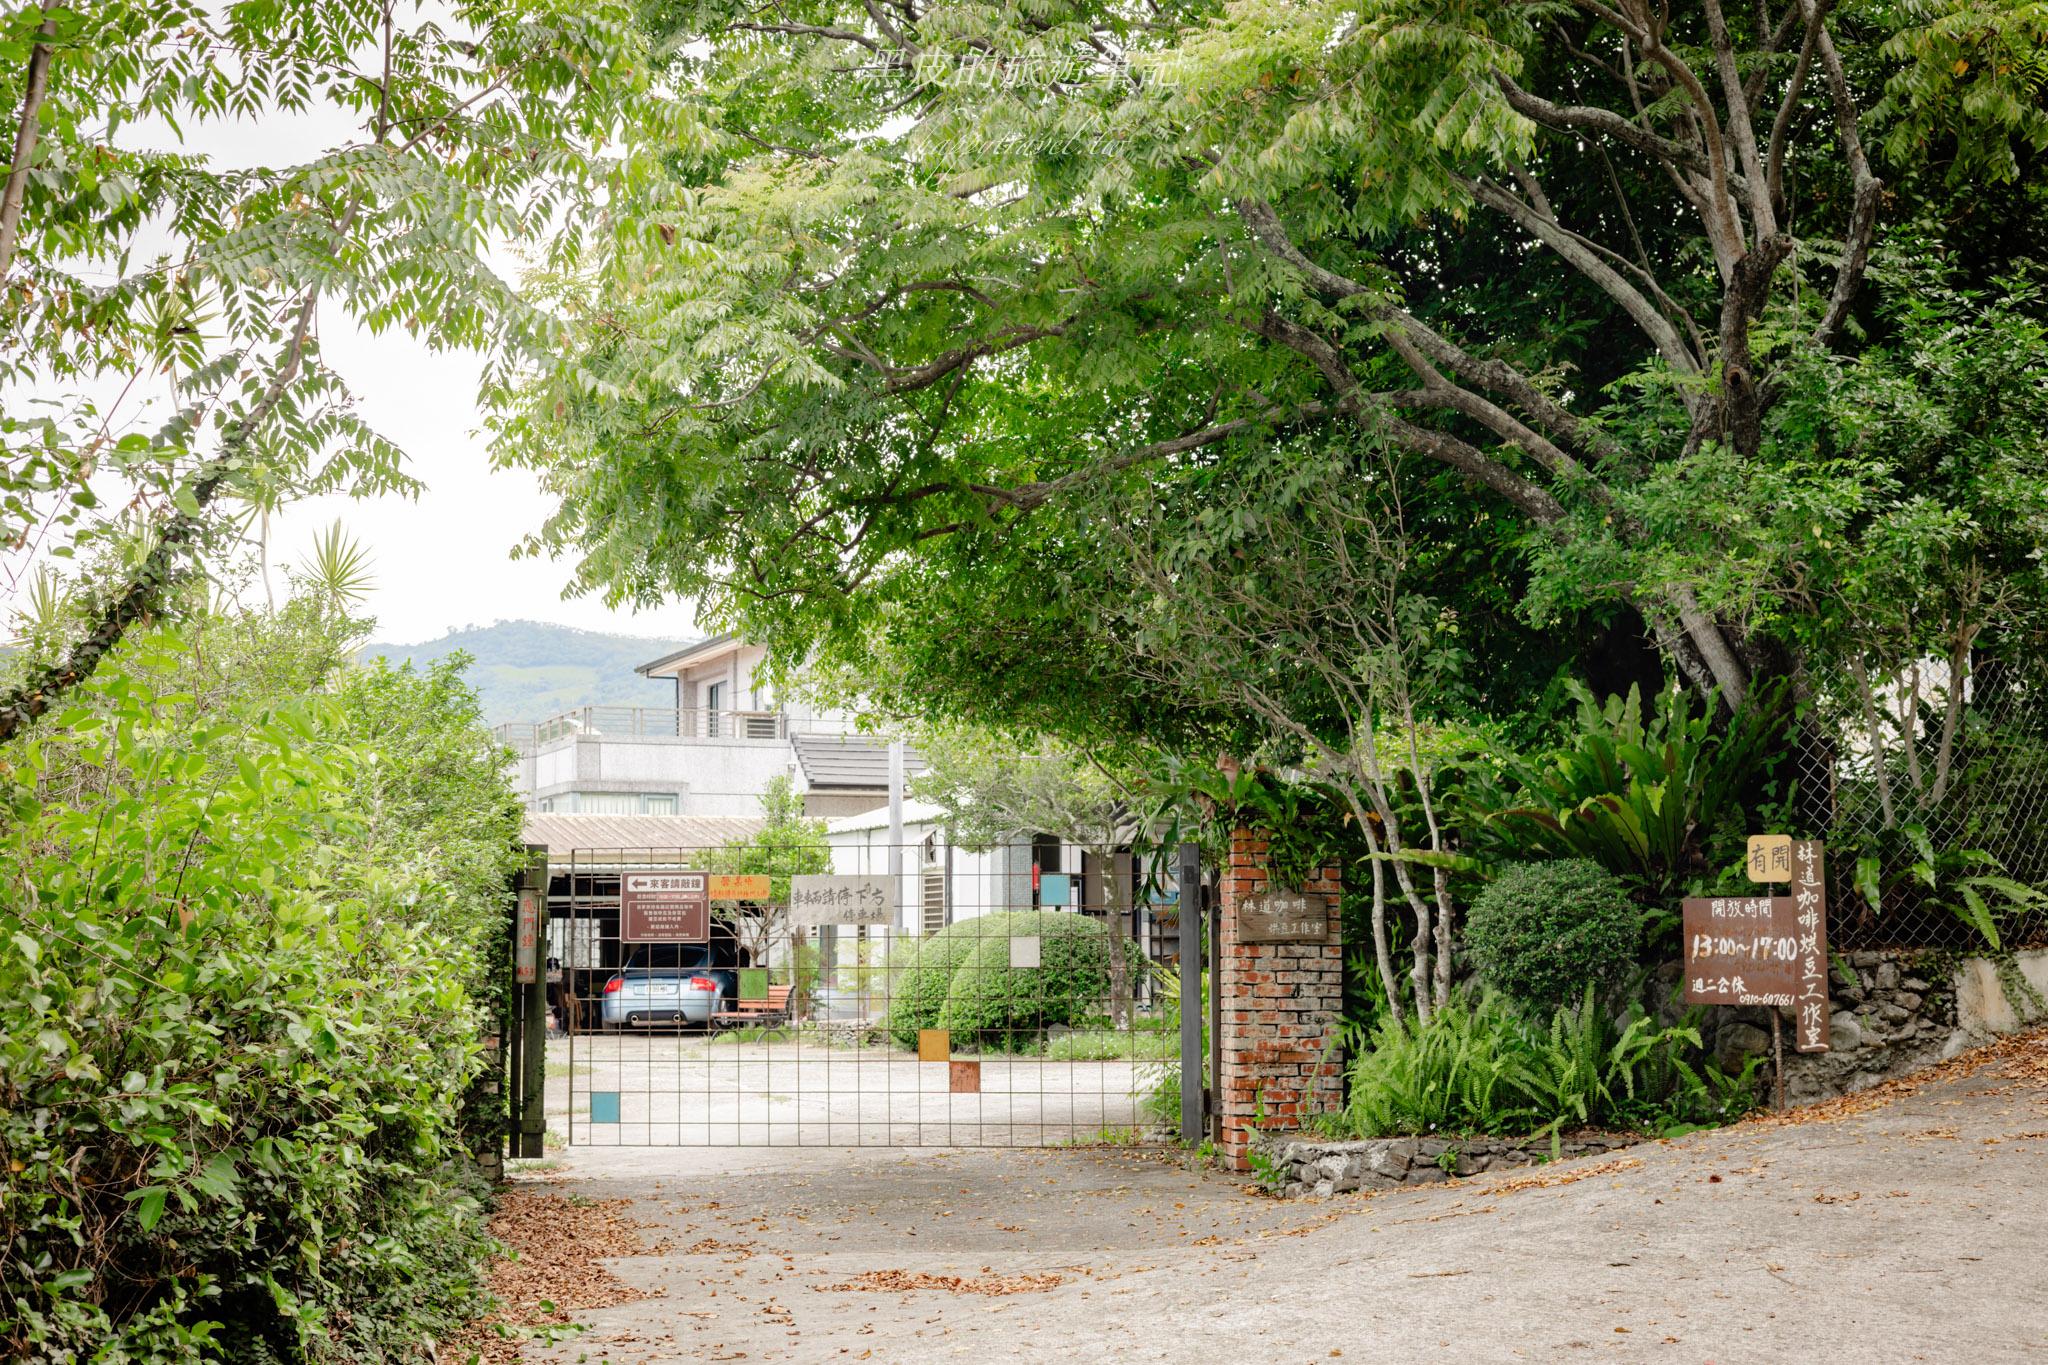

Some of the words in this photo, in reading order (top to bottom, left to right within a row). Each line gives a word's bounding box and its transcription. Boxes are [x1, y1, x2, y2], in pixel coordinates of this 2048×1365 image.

[1748, 844, 1790, 874] 有開
[650, 878, 701, 889] 來客請敲鐘
[1242, 897, 1307, 914] 林道咖啡
[1711, 898, 1772, 918] 開放時間
[1268, 921, 1323, 936] 烘豆工作室
[1691, 934, 1799, 964] 13:00~17:00
[1796, 841, 1829, 1050] 林道咖啡烘豆工作室
[1692, 976, 1748, 995] 週二公休
